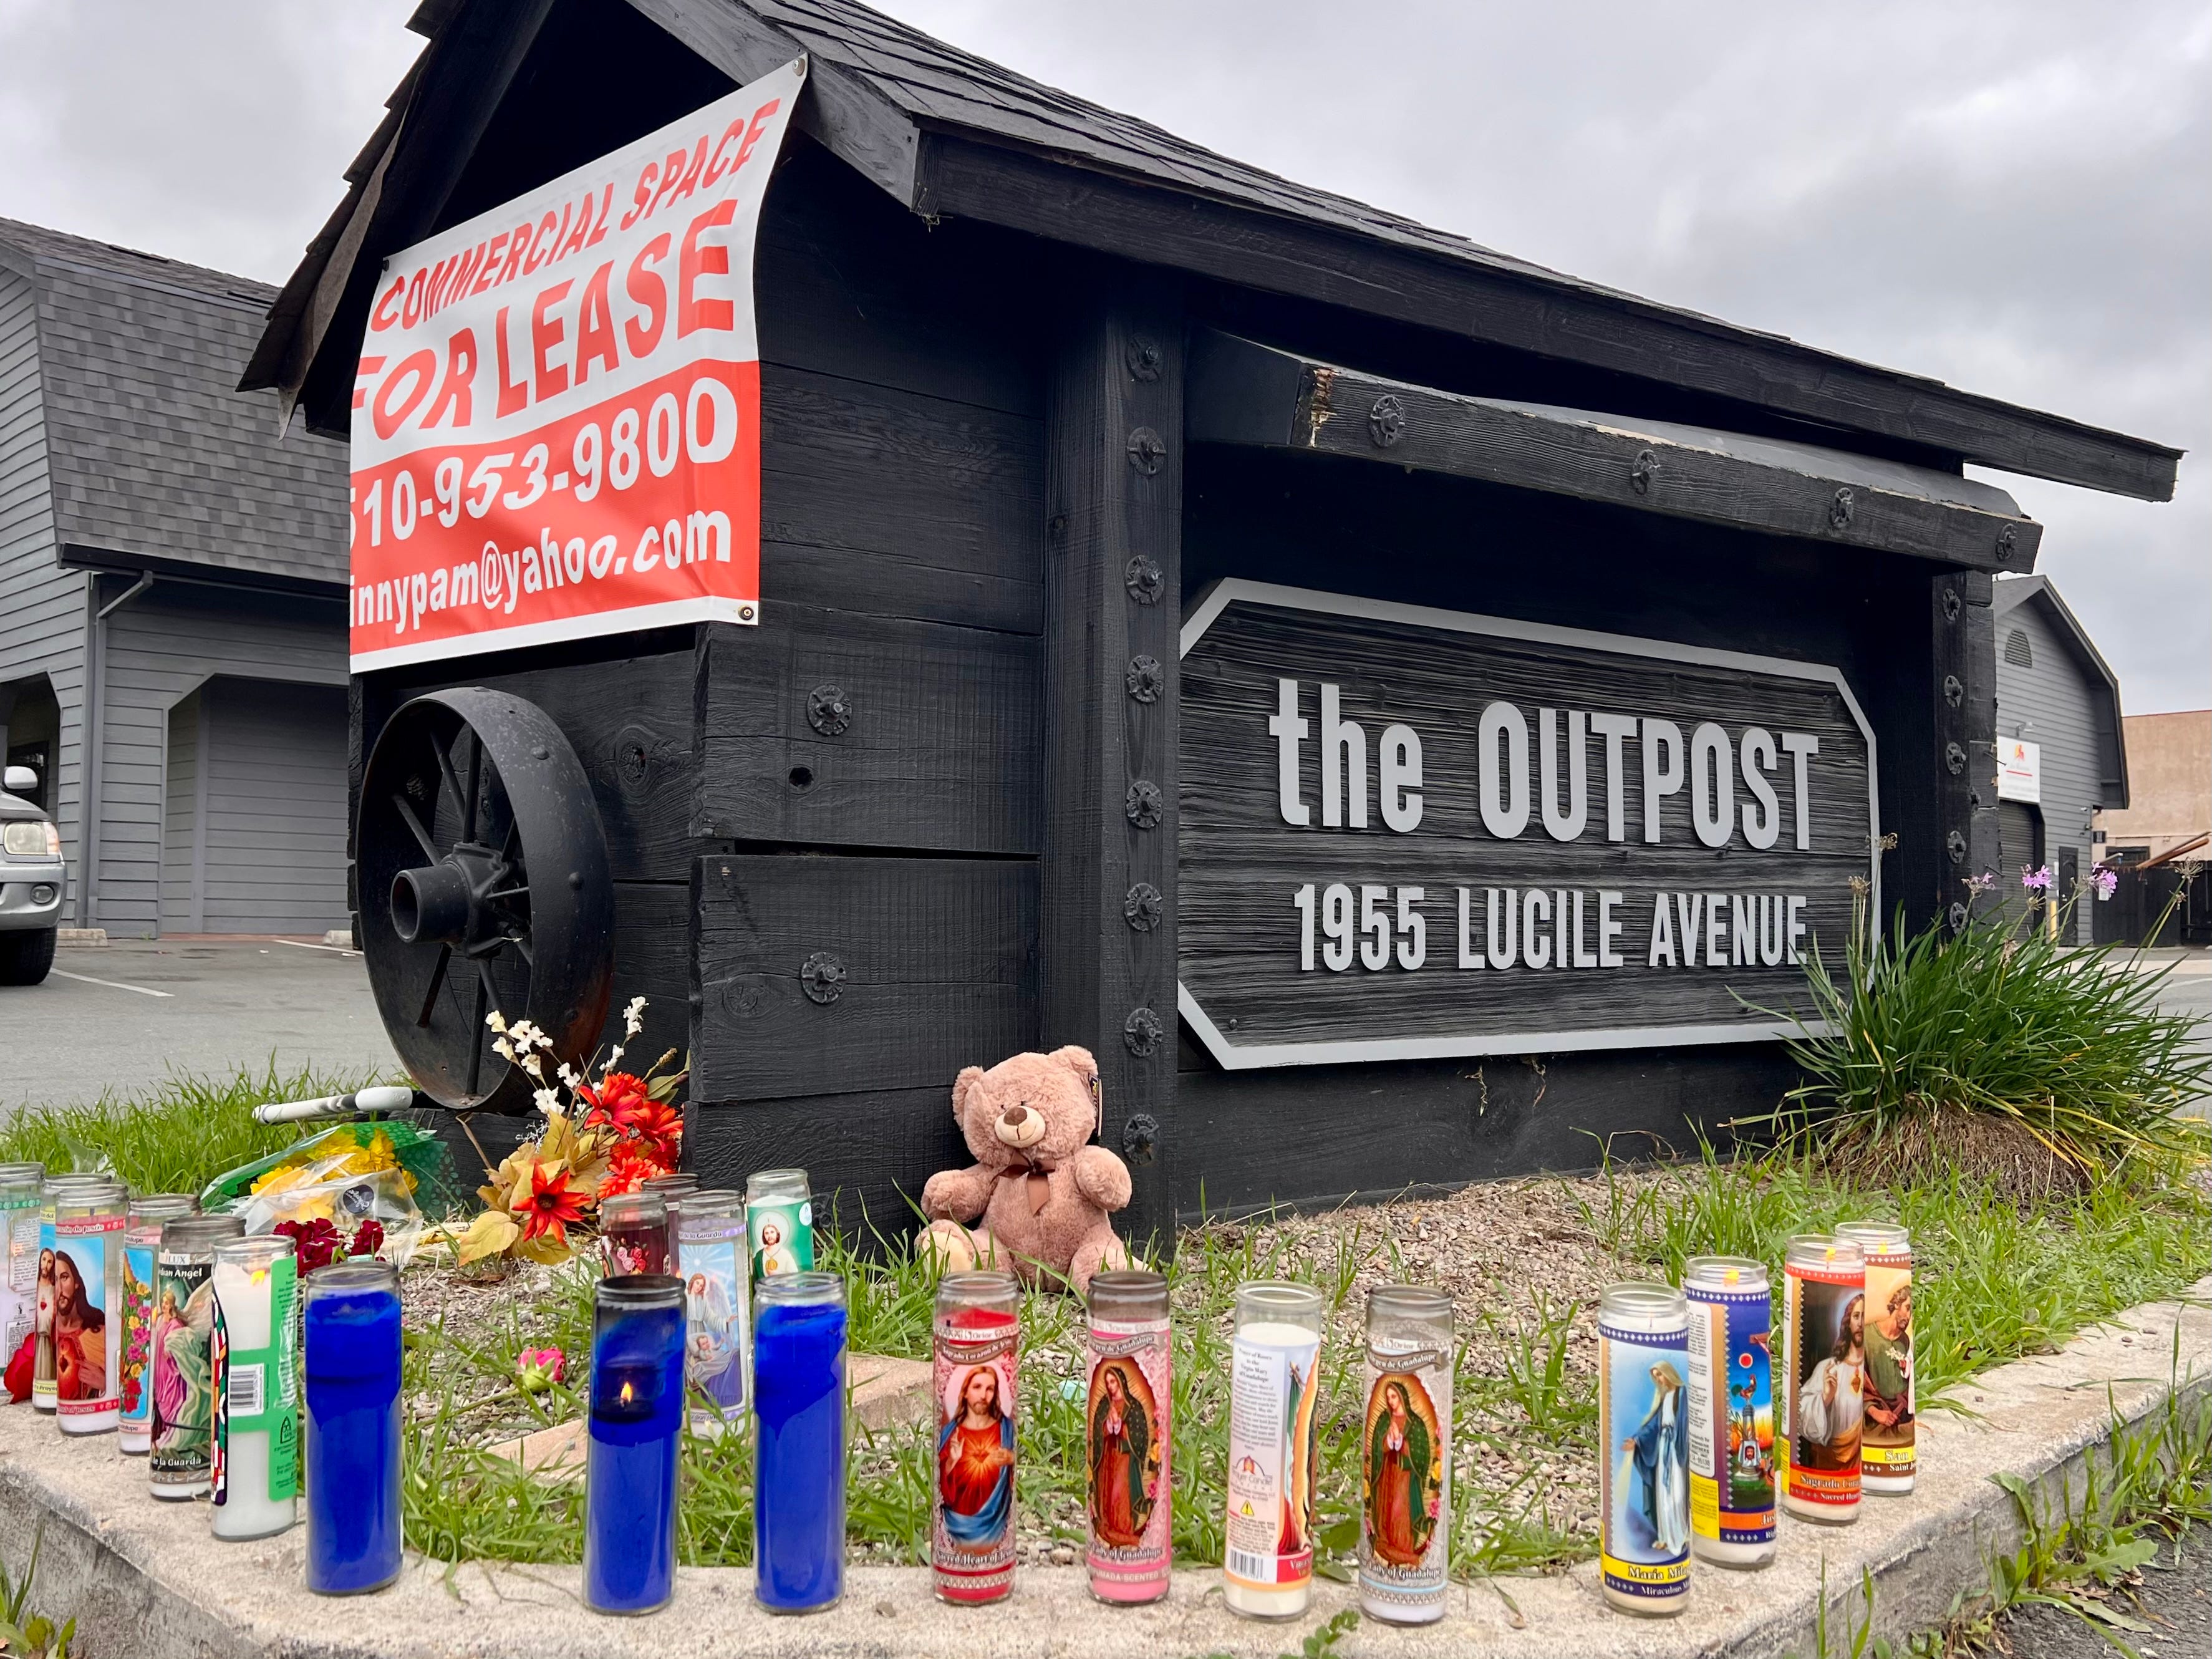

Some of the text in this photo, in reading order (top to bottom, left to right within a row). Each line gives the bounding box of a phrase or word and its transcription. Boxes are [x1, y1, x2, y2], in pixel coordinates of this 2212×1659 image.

[370, 97, 781, 332] COMMERCIAL SPACE
[351, 198, 737, 441] FOR LEASE
[350, 377, 738, 551] 10-953-9800
[1269, 678, 1819, 851] the OUTPOST
[1294, 883, 1807, 971] 1955 LUCILE AVENUE
[697, 1231, 722, 1239] Guarda
[175, 1267, 202, 1280] Angel
[1398, 1354, 1436, 1369] Guadalupe
[160, 1457, 166, 1466] la
[168, 1456, 201, 1466] Guarda
[1885, 1449, 1909, 1462] San
[1889, 1463, 1909, 1473] Saint
[1800, 1473, 1840, 1489] Sagrado
[1820, 1492, 1845, 1501] Sacred
[1119, 1547, 1163, 1561] Guadalupe
[1387, 1566, 1397, 1579] of
[1398, 1567, 1442, 1580] Guadalupe
[1628, 1565, 1664, 1580] María
[1641, 1585, 1683, 1595] Miraculous
